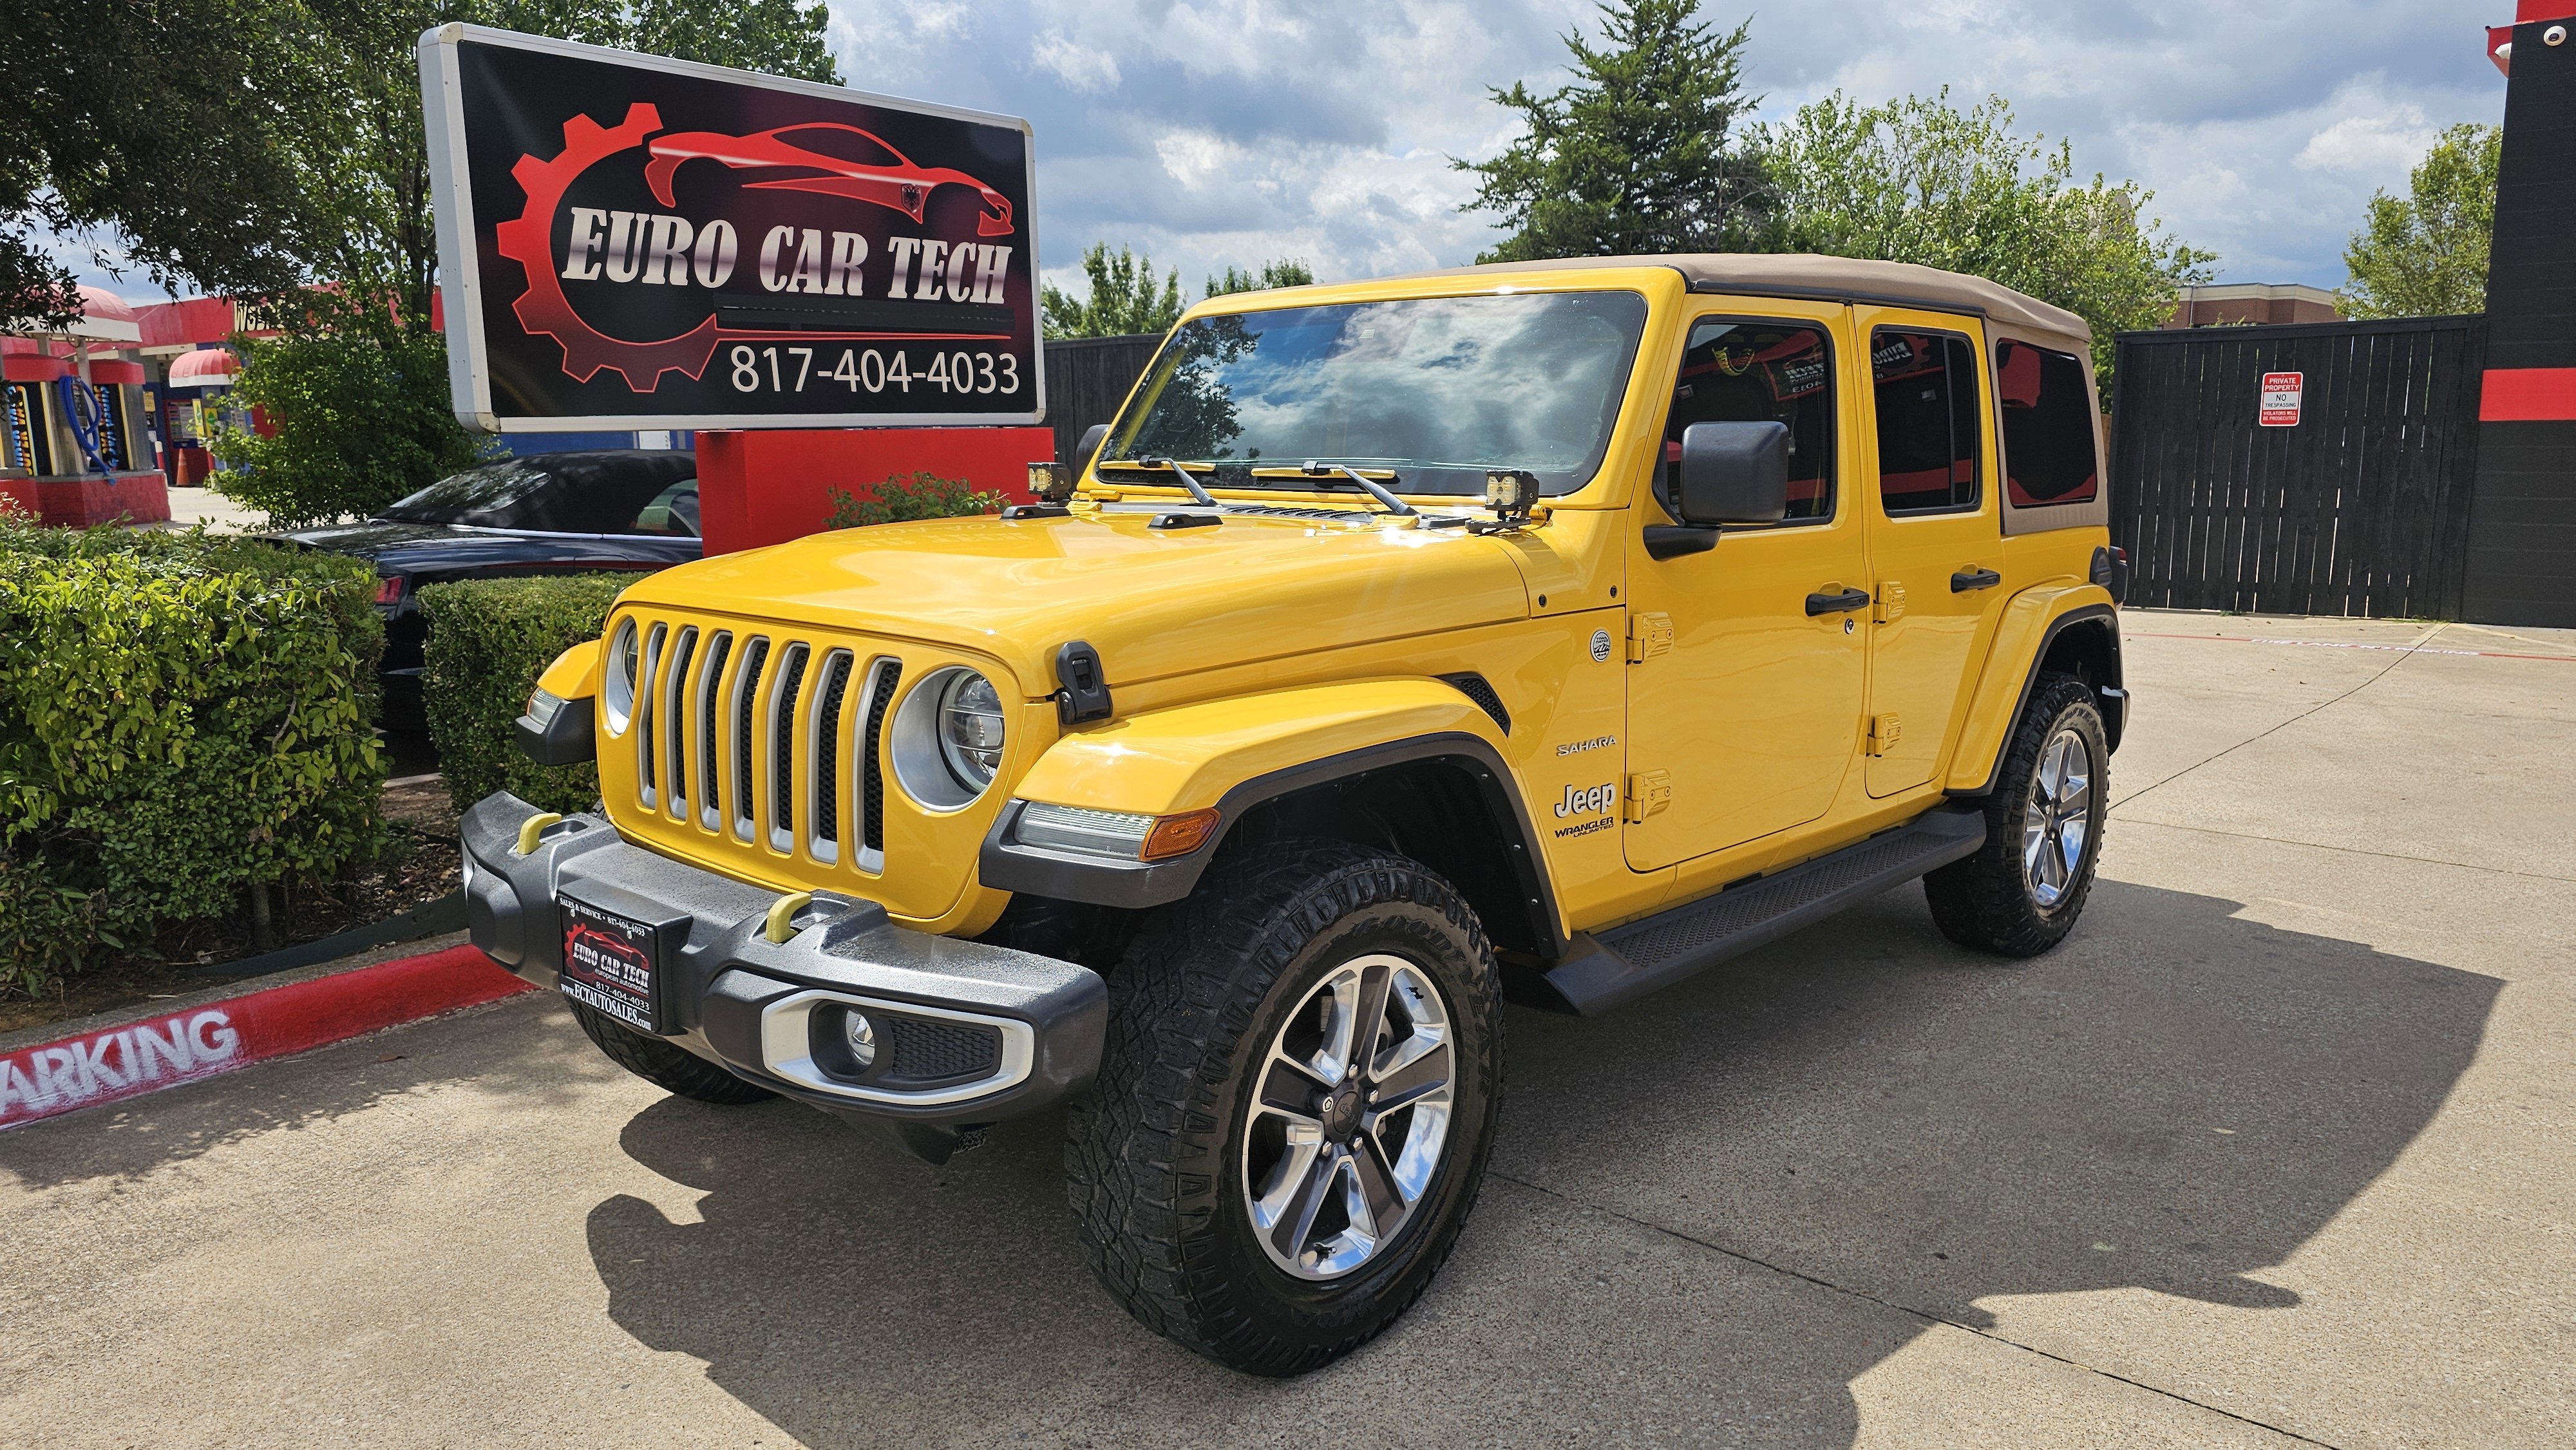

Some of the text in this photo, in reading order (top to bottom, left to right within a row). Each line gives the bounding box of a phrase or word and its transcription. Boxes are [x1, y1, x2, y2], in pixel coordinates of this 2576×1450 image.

[562, 207, 1012, 305] EURO CAR TECH
[730, 346, 1019, 395] 817-404-4033
[1556, 735, 1617, 757] SAHARA
[1554, 783, 1616, 818] Jeep
[1555, 816, 1614, 838] WRANGLER
[1573, 824, 1614, 838] UNLIMITED
[560, 898, 574, 909] SALES
[580, 906, 602, 920] SERVICE
[607, 916, 645, 936] 817-404-4033
[573, 943, 649, 988] EURO CAR TECH
[595, 968, 649, 995] european automotive
[560, 983, 651, 1031] www.ECTAUTOSALES.com
[596, 981, 650, 1011] 817-404-4033
[0, 1011, 235, 1115] ARKING
